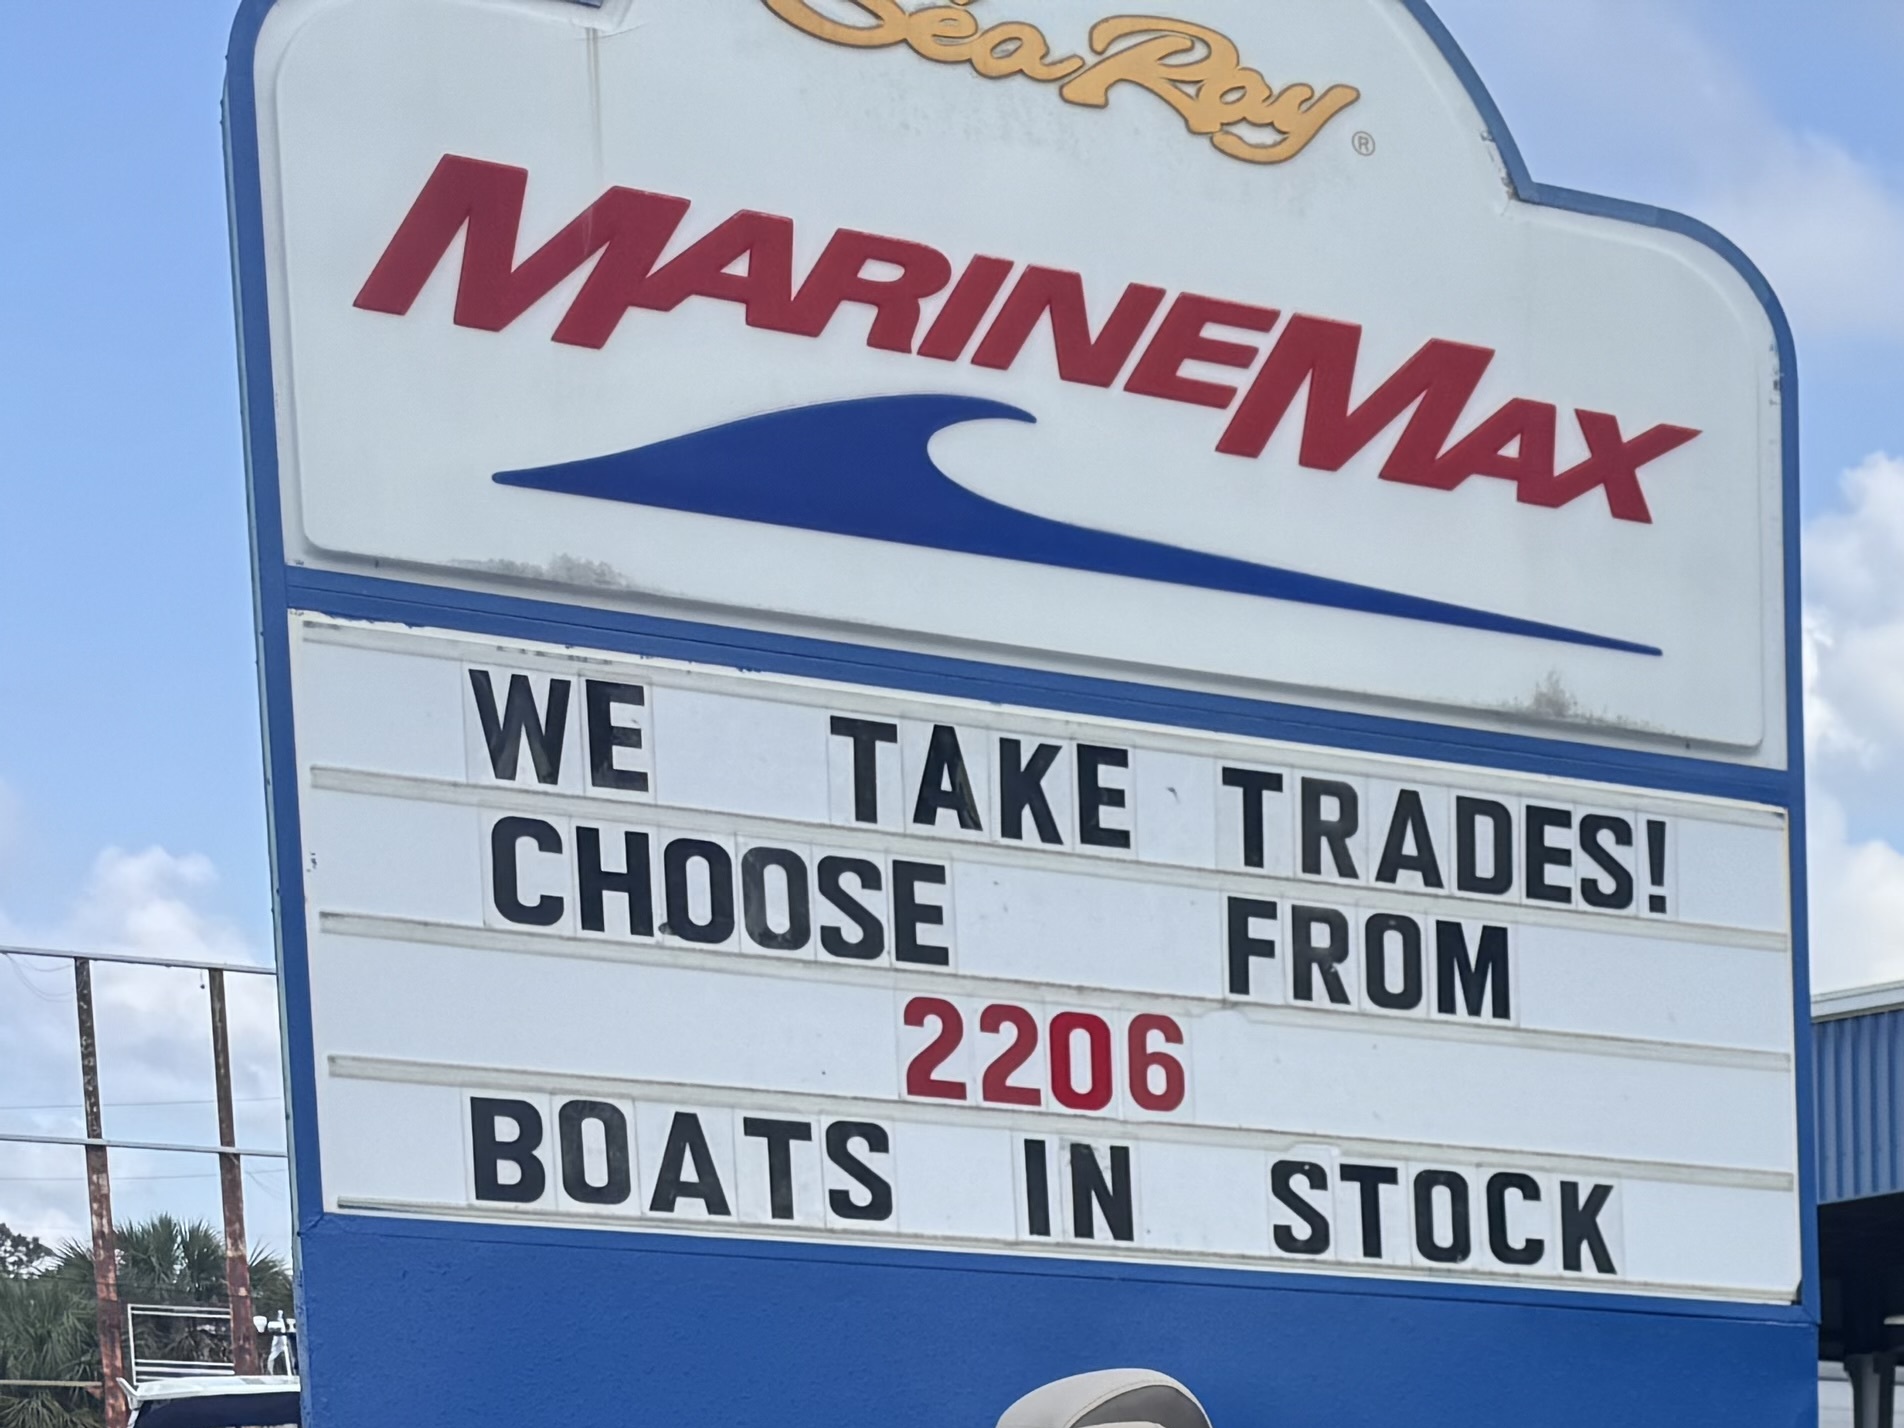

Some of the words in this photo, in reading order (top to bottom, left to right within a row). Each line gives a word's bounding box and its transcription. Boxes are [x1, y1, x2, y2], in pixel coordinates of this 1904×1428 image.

[1059, 13, 1361, 165] Ray
[468, 668, 650, 793] WE
[829, 714, 1132, 849] TAKE
[1221, 766, 1668, 915] TRADES!
[490, 816, 950, 966] CHOOSE
[1226, 895, 1511, 1021] FROM
[903, 996, 1186, 1112] 2206
[469, 1096, 893, 1222] BOATS
[1023, 1138, 1135, 1242] IN
[1270, 1159, 1618, 1275] STOCK
